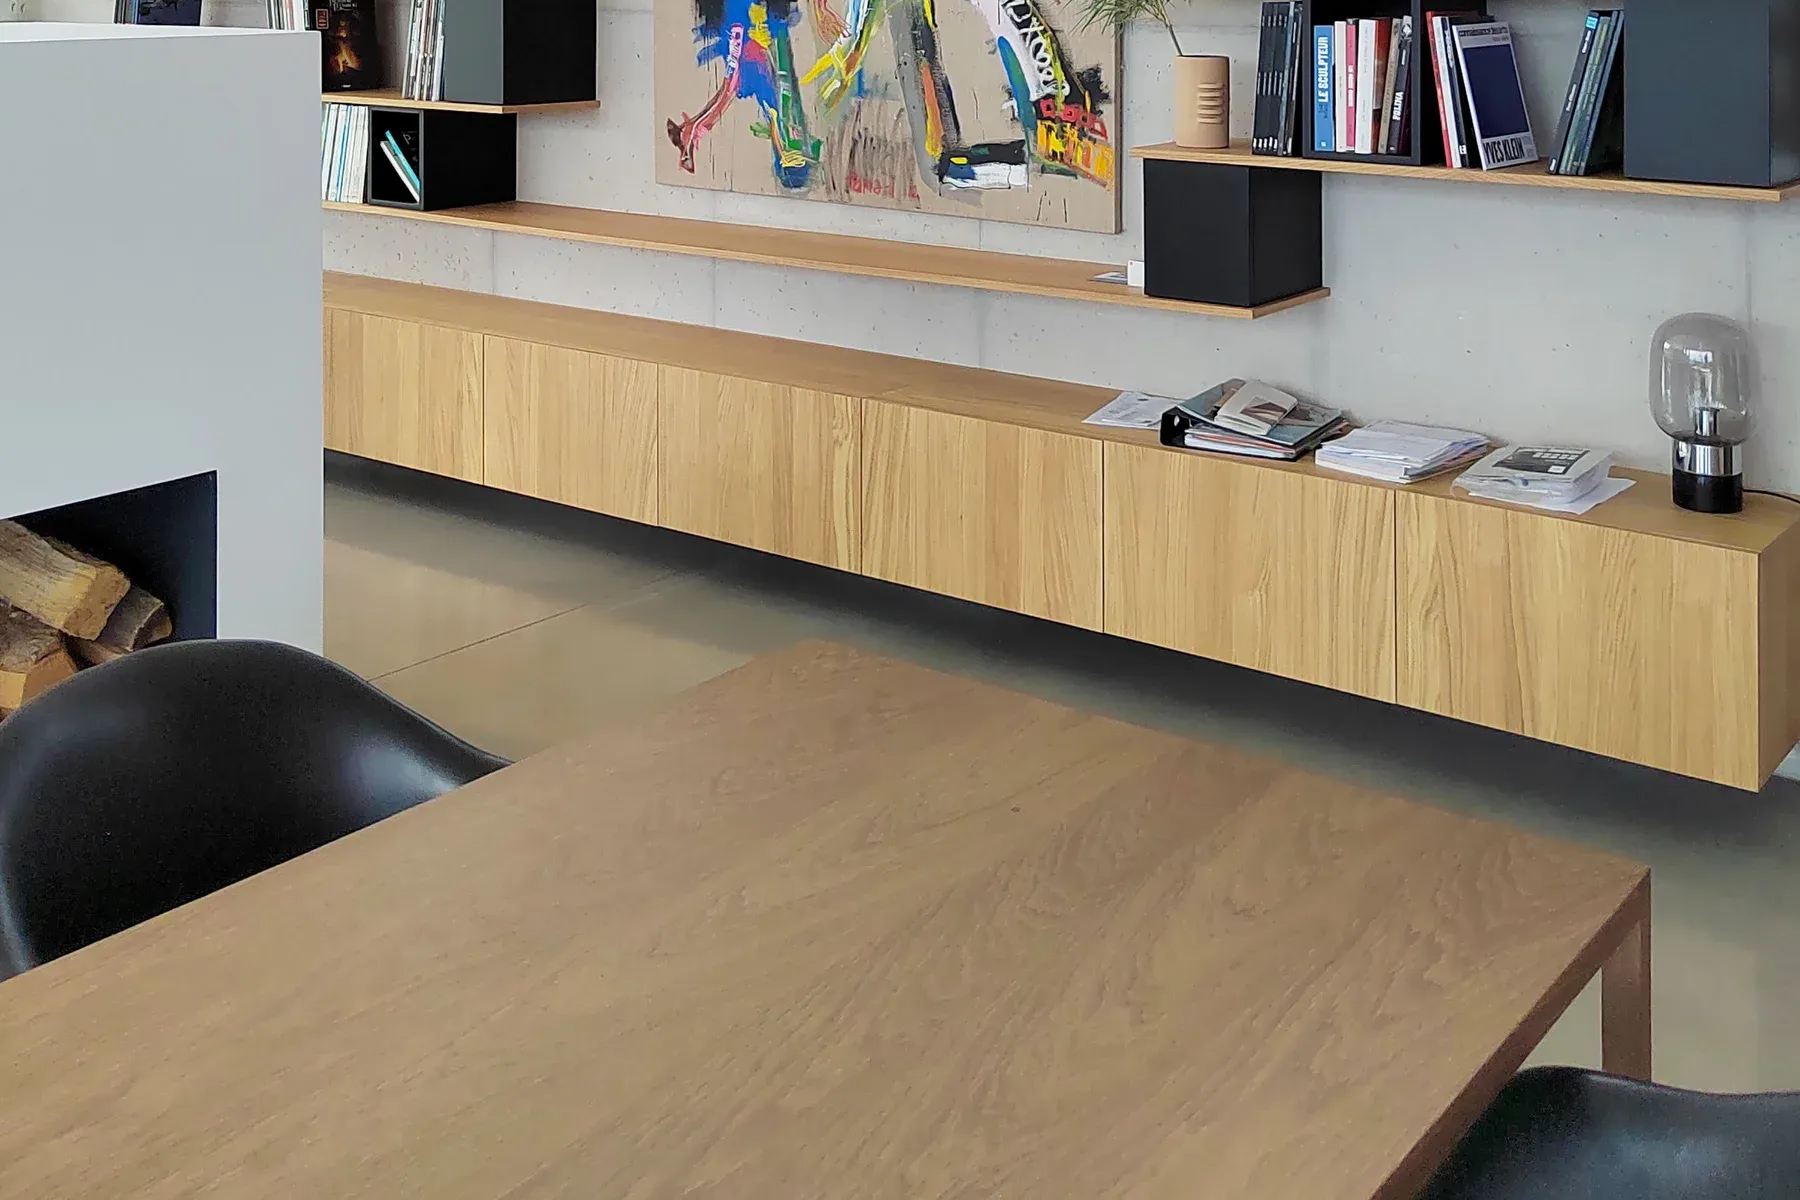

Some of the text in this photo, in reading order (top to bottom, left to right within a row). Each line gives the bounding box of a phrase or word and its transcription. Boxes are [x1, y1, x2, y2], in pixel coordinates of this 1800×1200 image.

[1317, 36, 1329, 90] SCULPTEUR
[1318, 91, 1329, 103] LE
[1392, 91, 1404, 121] POLINA
[1483, 137, 1526, 166] YVES KLEIN
